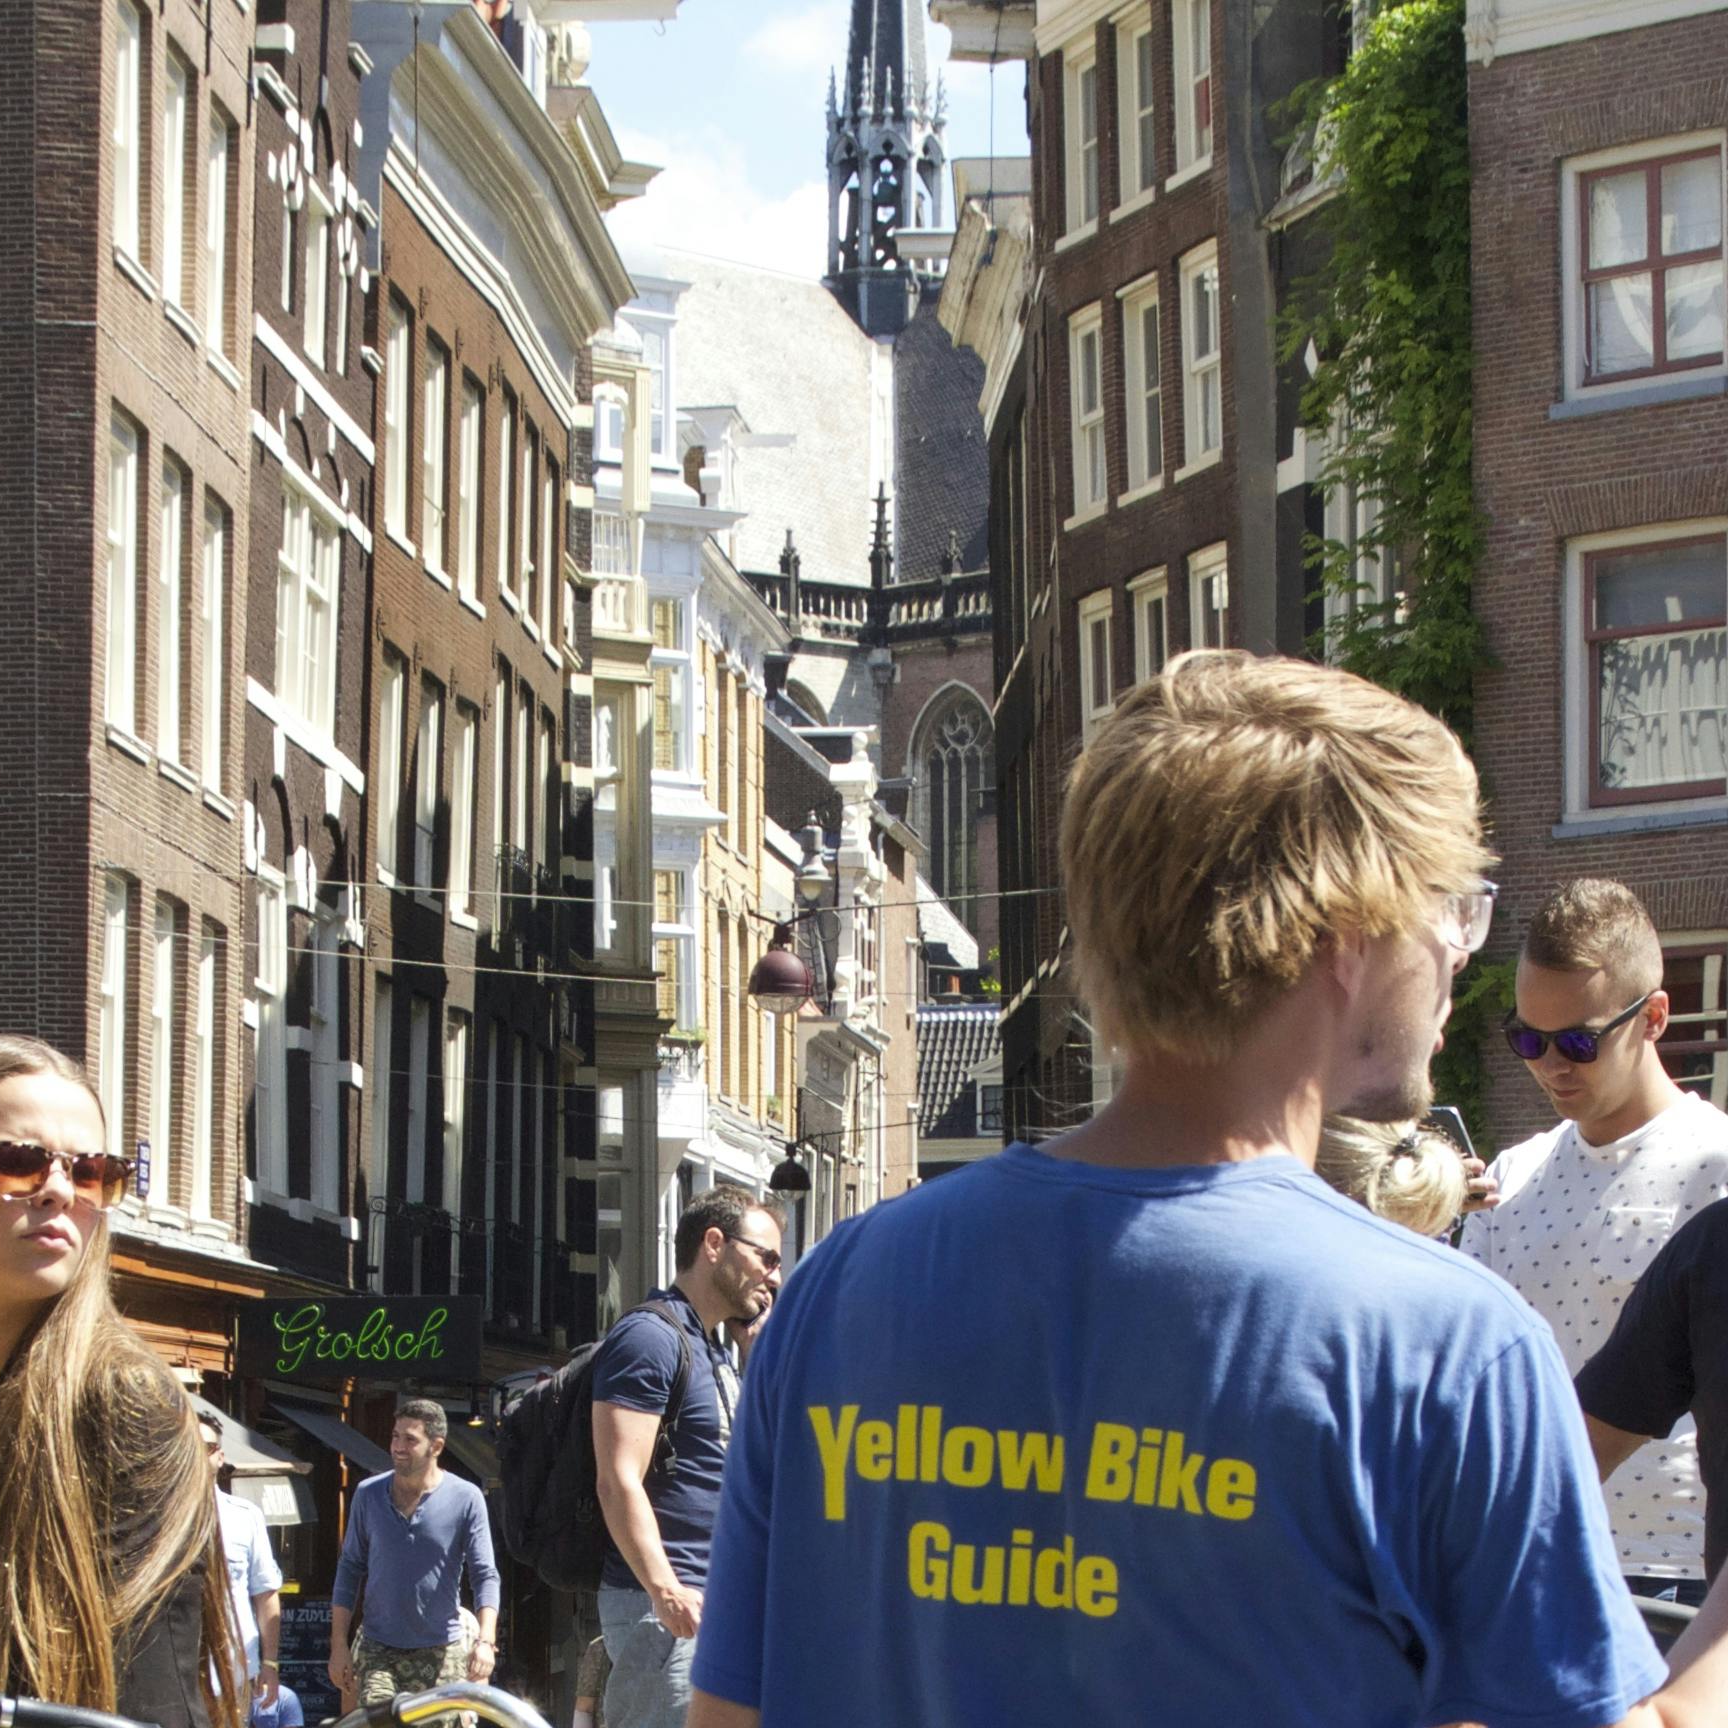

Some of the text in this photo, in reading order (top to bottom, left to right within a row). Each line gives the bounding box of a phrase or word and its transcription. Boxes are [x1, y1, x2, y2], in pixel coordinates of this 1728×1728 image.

[273, 1304, 448, 1373] Grolsch
[808, 1404, 1258, 1521] Yellow Bike
[908, 1521, 1119, 1618] Guide
[297, 1607, 334, 1623] ZUYLE
